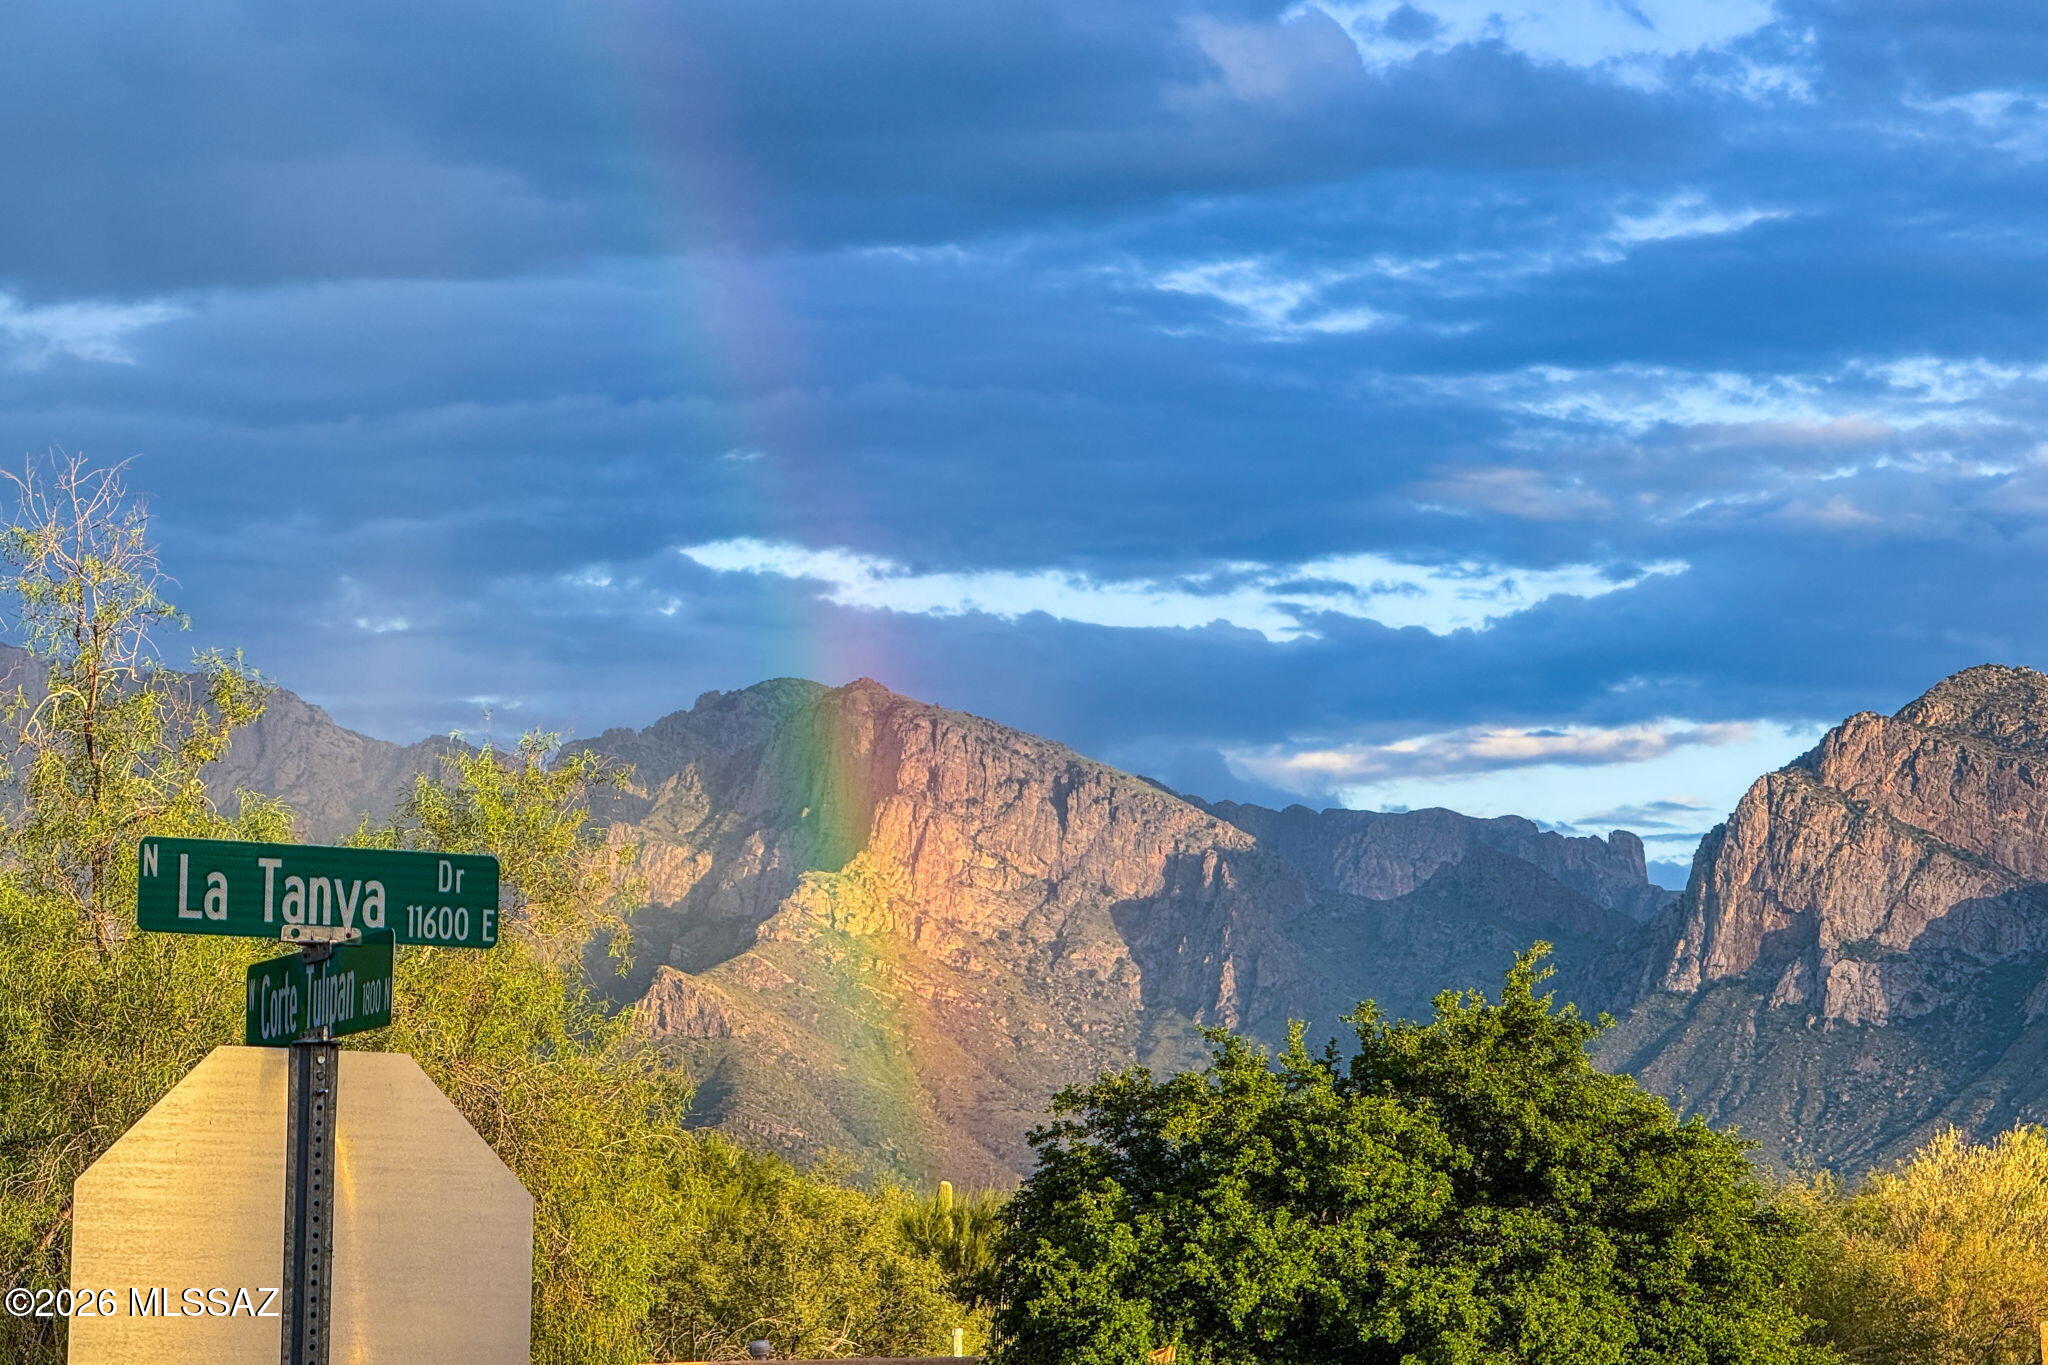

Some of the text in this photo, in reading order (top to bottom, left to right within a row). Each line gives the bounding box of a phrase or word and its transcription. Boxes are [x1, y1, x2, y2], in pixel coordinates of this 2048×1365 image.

[143, 843, 465, 931] N La Tanya Dr
[406, 905, 495, 942] 11600 E
[260, 970, 298, 1040] Corte
[305, 960, 355, 1037] Tulipan
[362, 979, 381, 1017] 1800
[384, 976, 391, 1011] N
